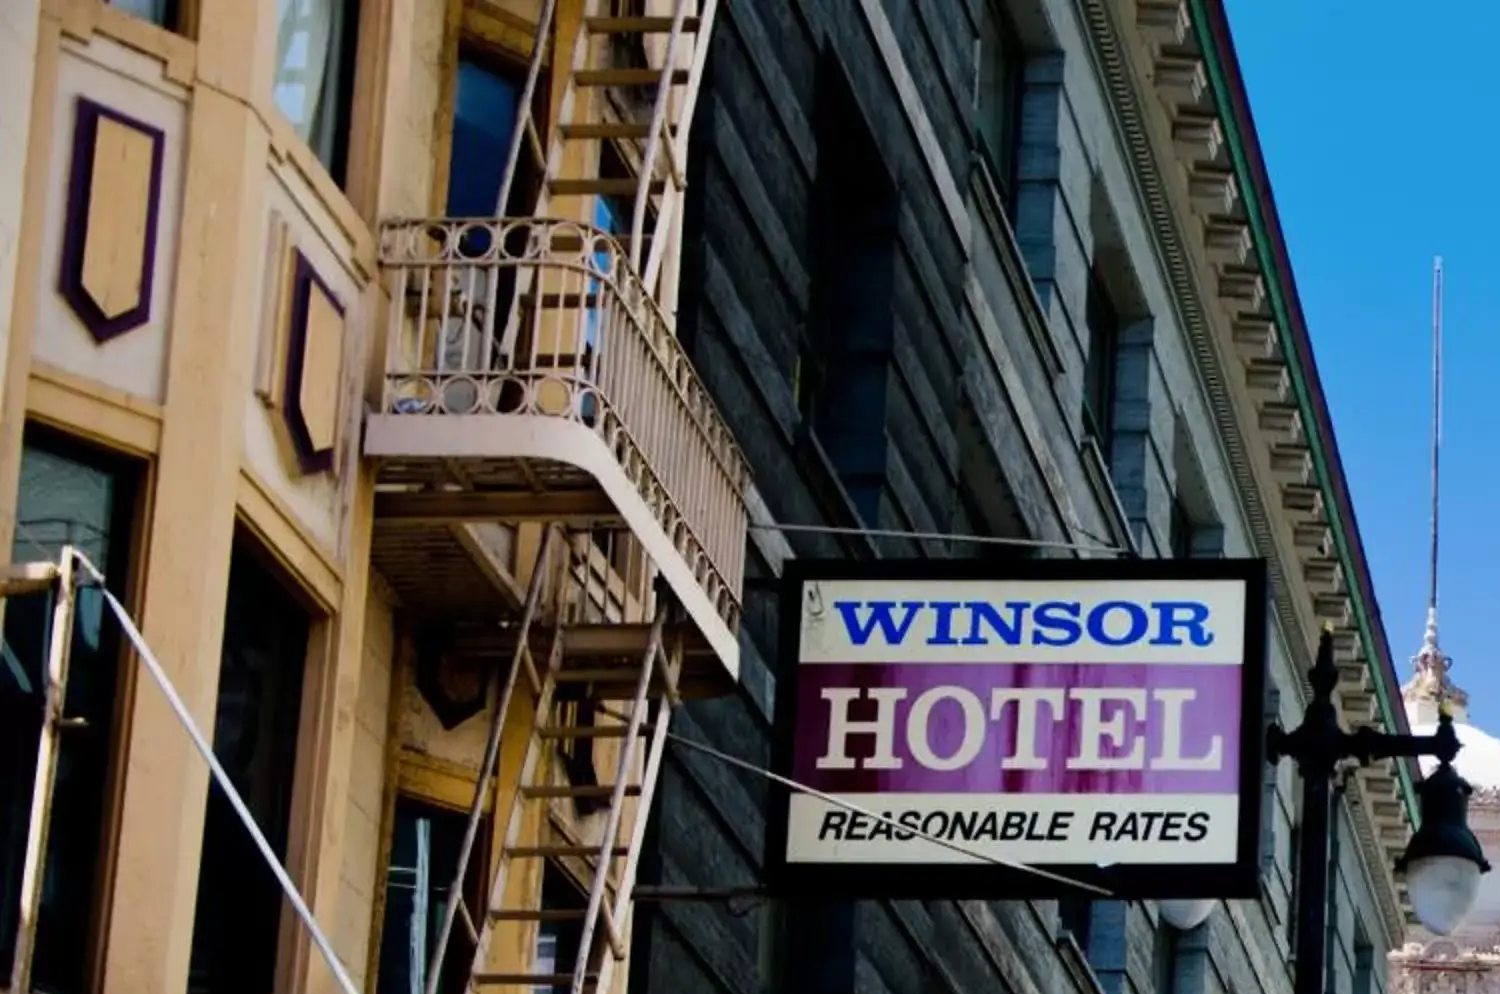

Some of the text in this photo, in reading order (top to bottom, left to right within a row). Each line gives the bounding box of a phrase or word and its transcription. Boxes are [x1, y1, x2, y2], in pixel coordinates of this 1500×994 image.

[834, 600, 1216, 647] WINSOR
[815, 685, 1223, 772] HOTEL
[818, 811, 1210, 842] REASONABLE RATES
